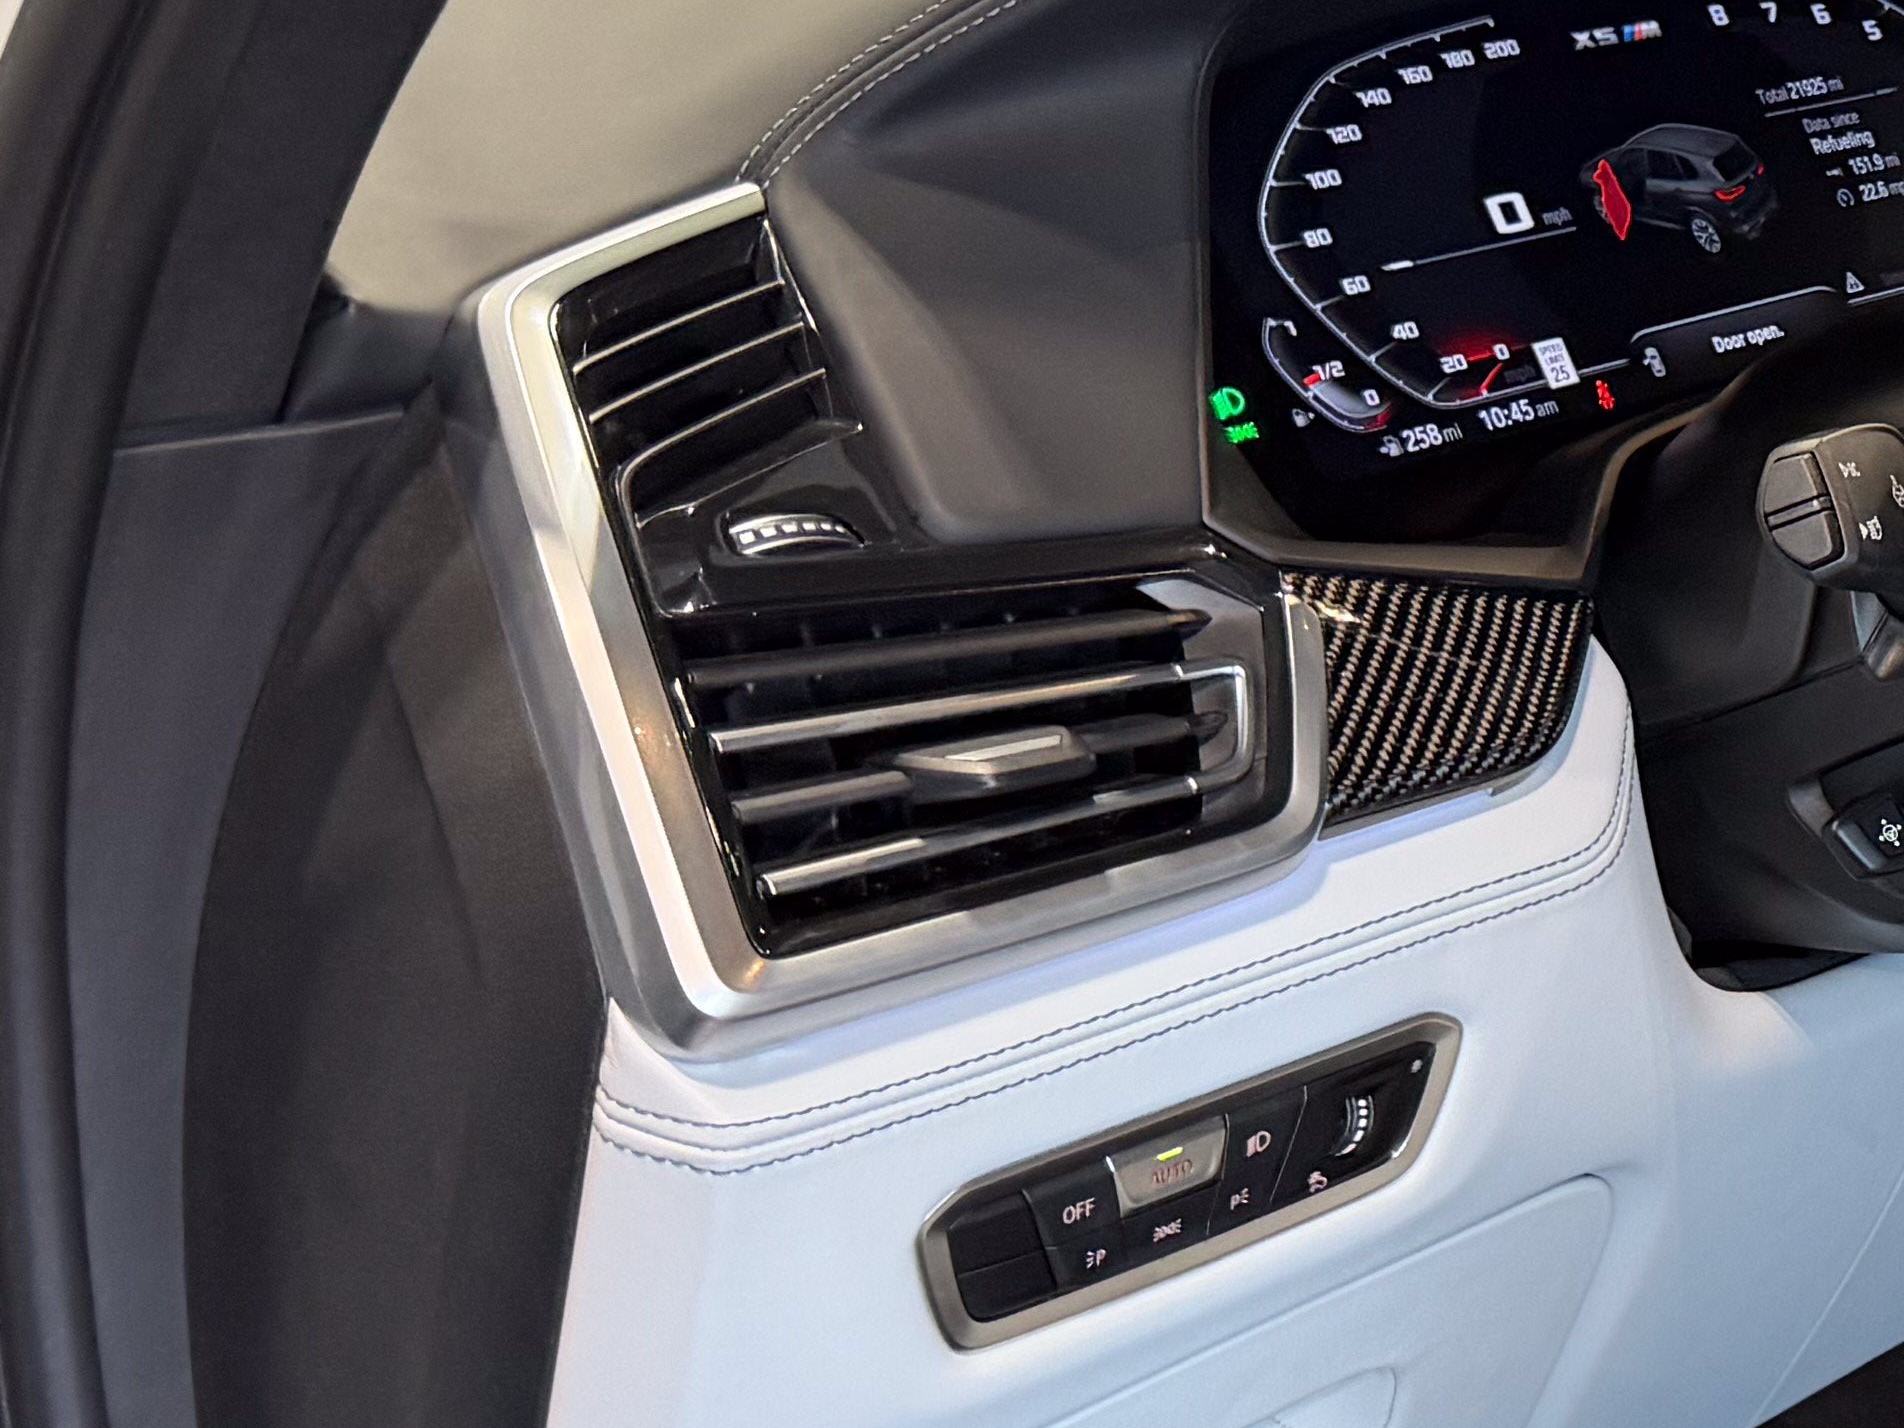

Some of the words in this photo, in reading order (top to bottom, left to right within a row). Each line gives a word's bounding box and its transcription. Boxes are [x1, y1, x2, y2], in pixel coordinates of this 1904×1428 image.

[1707, 4, 1730, 26] 8
[1759, 1, 1777, 22] 7
[1810, 3, 1831, 24] 6
[1570, 27, 1619, 51] X5
[1862, 19, 1883, 41] 5
[1440, 49, 1475, 68] 180
[1483, 39, 1521, 59] 200
[1398, 65, 1433, 84] 160
[1356, 87, 1392, 107] 140
[1755, 85, 1789, 105] Total
[1787, 76, 1827, 100] 21925
[1827, 75, 1844, 92] mi
[1326, 123, 1362, 144] 120
[1802, 116, 1831, 134] Data
[1830, 112, 1860, 129] since
[1809, 130, 1876, 155] Refueling
[1848, 153, 1885, 175] 151.9
[1884, 152, 1901, 169] mi
[1305, 169, 1342, 190] 100
[1858, 181, 1889, 202] 22.6
[1484, 191, 1535, 234] 0
[1542, 207, 1573, 227] mph
[1303, 228, 1333, 248] 80
[1341, 275, 1371, 295] 60
[1391, 321, 1419, 340] 40
[1711, 333, 1747, 353] Door
[1748, 325, 1785, 346] open.
[1492, 343, 1510, 360] 0
[1312, 359, 1345, 381] 1/2
[1439, 353, 1468, 373] 20
[1550, 365, 1571, 383] 25
[1361, 388, 1380, 406] 0
[1477, 399, 1535, 430] 10:45
[1535, 400, 1560, 417] am
[1402, 424, 1443, 452] 258
[1442, 423, 1464, 443] mi
[1151, 1159, 1194, 1186] AUTO
[1062, 1197, 1096, 1225] OFF
